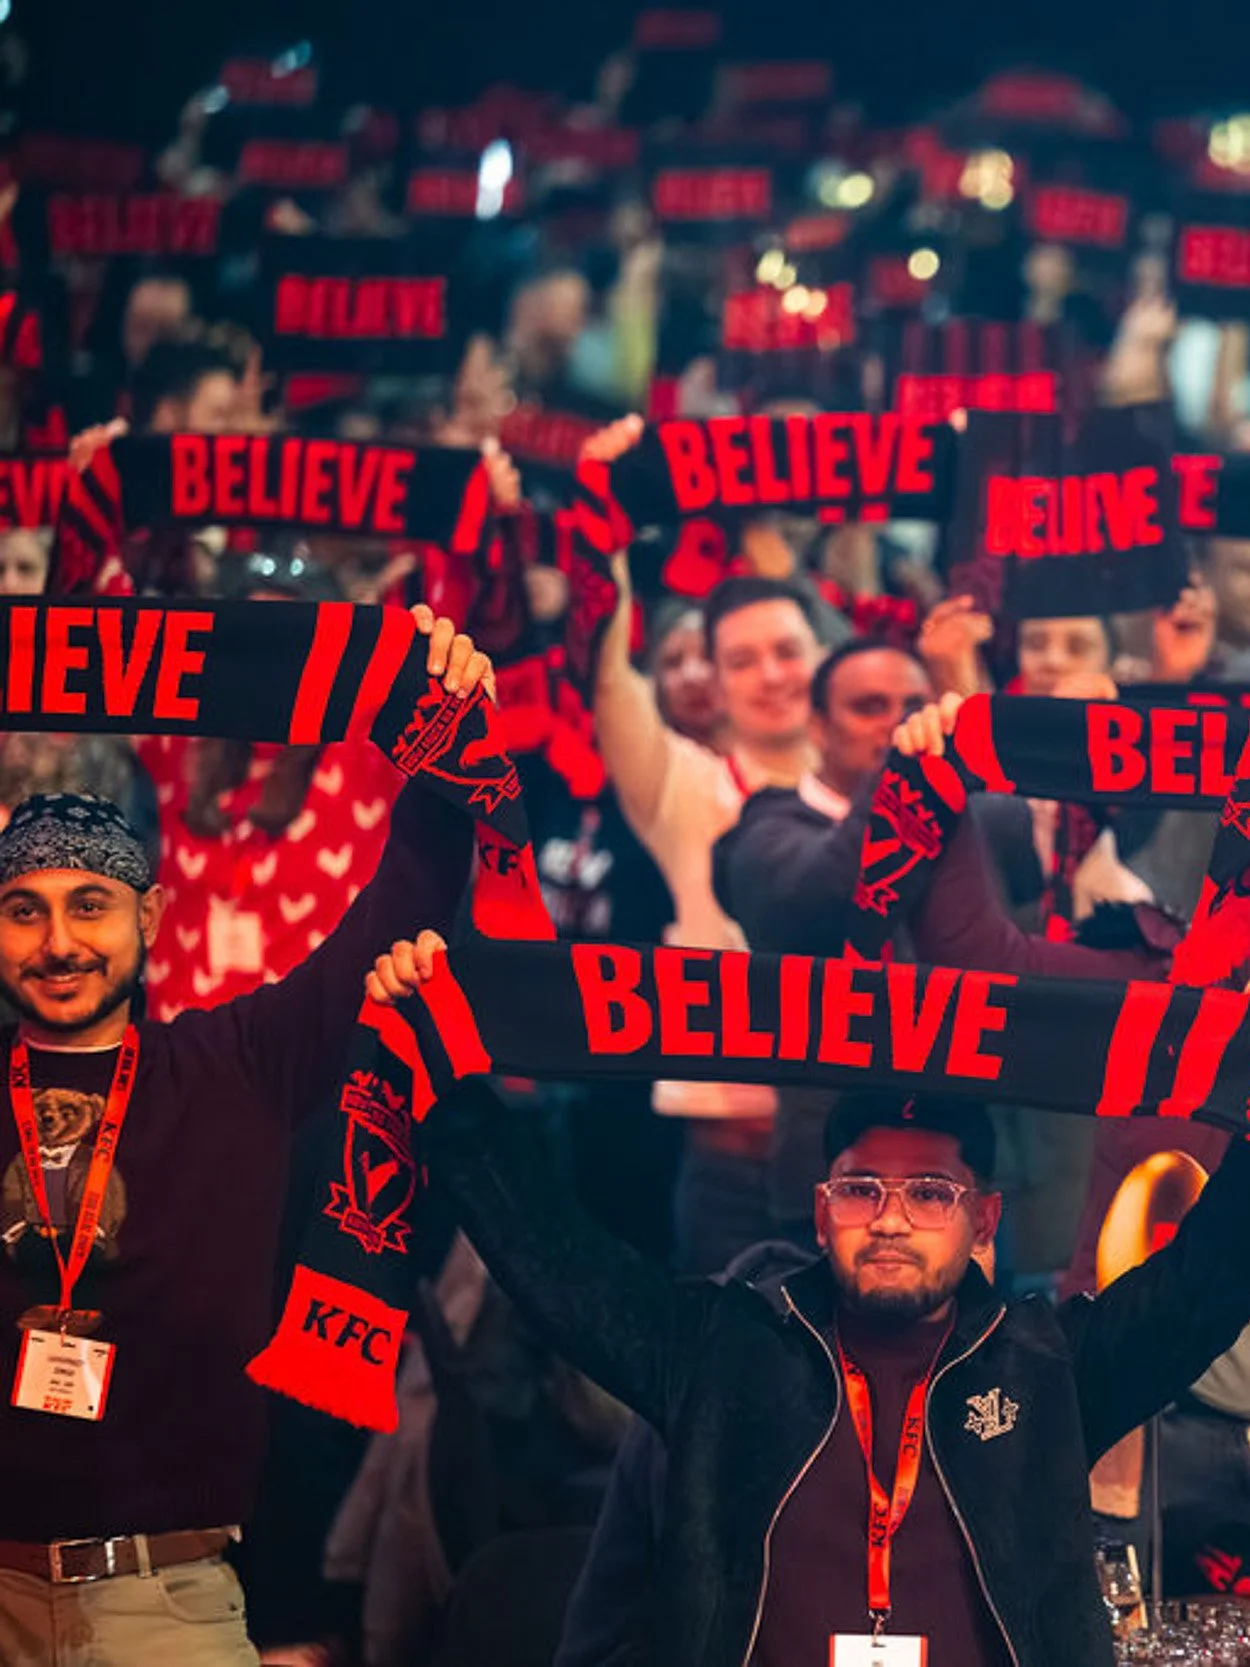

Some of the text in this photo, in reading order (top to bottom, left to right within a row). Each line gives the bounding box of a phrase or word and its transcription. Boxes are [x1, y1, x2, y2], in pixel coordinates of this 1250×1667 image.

[172, 434, 416, 531] BELIEVE
[660, 413, 932, 510] BELIEVE
[571, 943, 1019, 1080] BELIEVE
[302, 1299, 392, 1366] KFC
[902, 1417, 921, 1459] KFC
[872, 1502, 888, 1549] KFC
